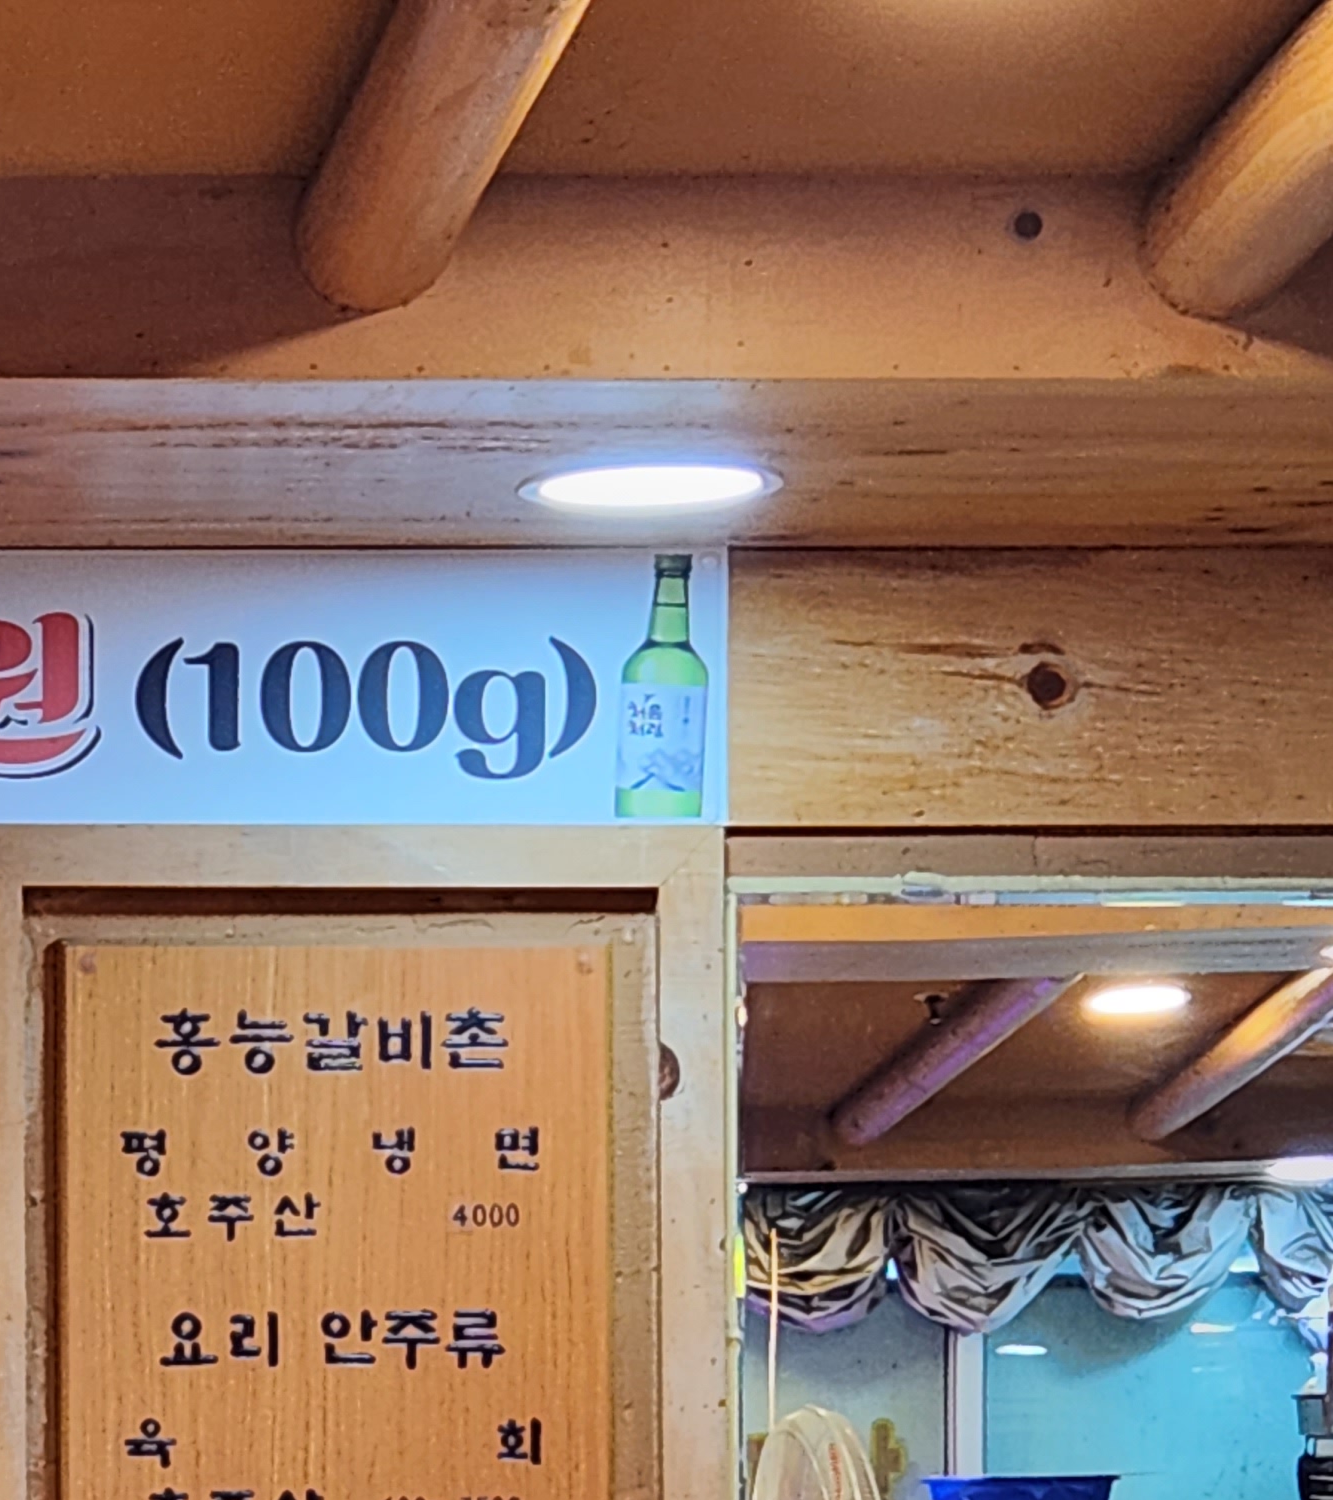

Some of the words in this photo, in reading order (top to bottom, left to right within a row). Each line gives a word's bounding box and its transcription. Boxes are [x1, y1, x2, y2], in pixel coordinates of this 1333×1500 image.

[134, 634, 598, 780] (100g)
[154, 1007, 509, 1076] 홍능갈비촌
[144, 1192, 321, 1242] 호주산
[452, 1202, 520, 1228] 4000
[159, 1311, 279, 1367] 요리
[320, 1309, 506, 1370] 안주류
